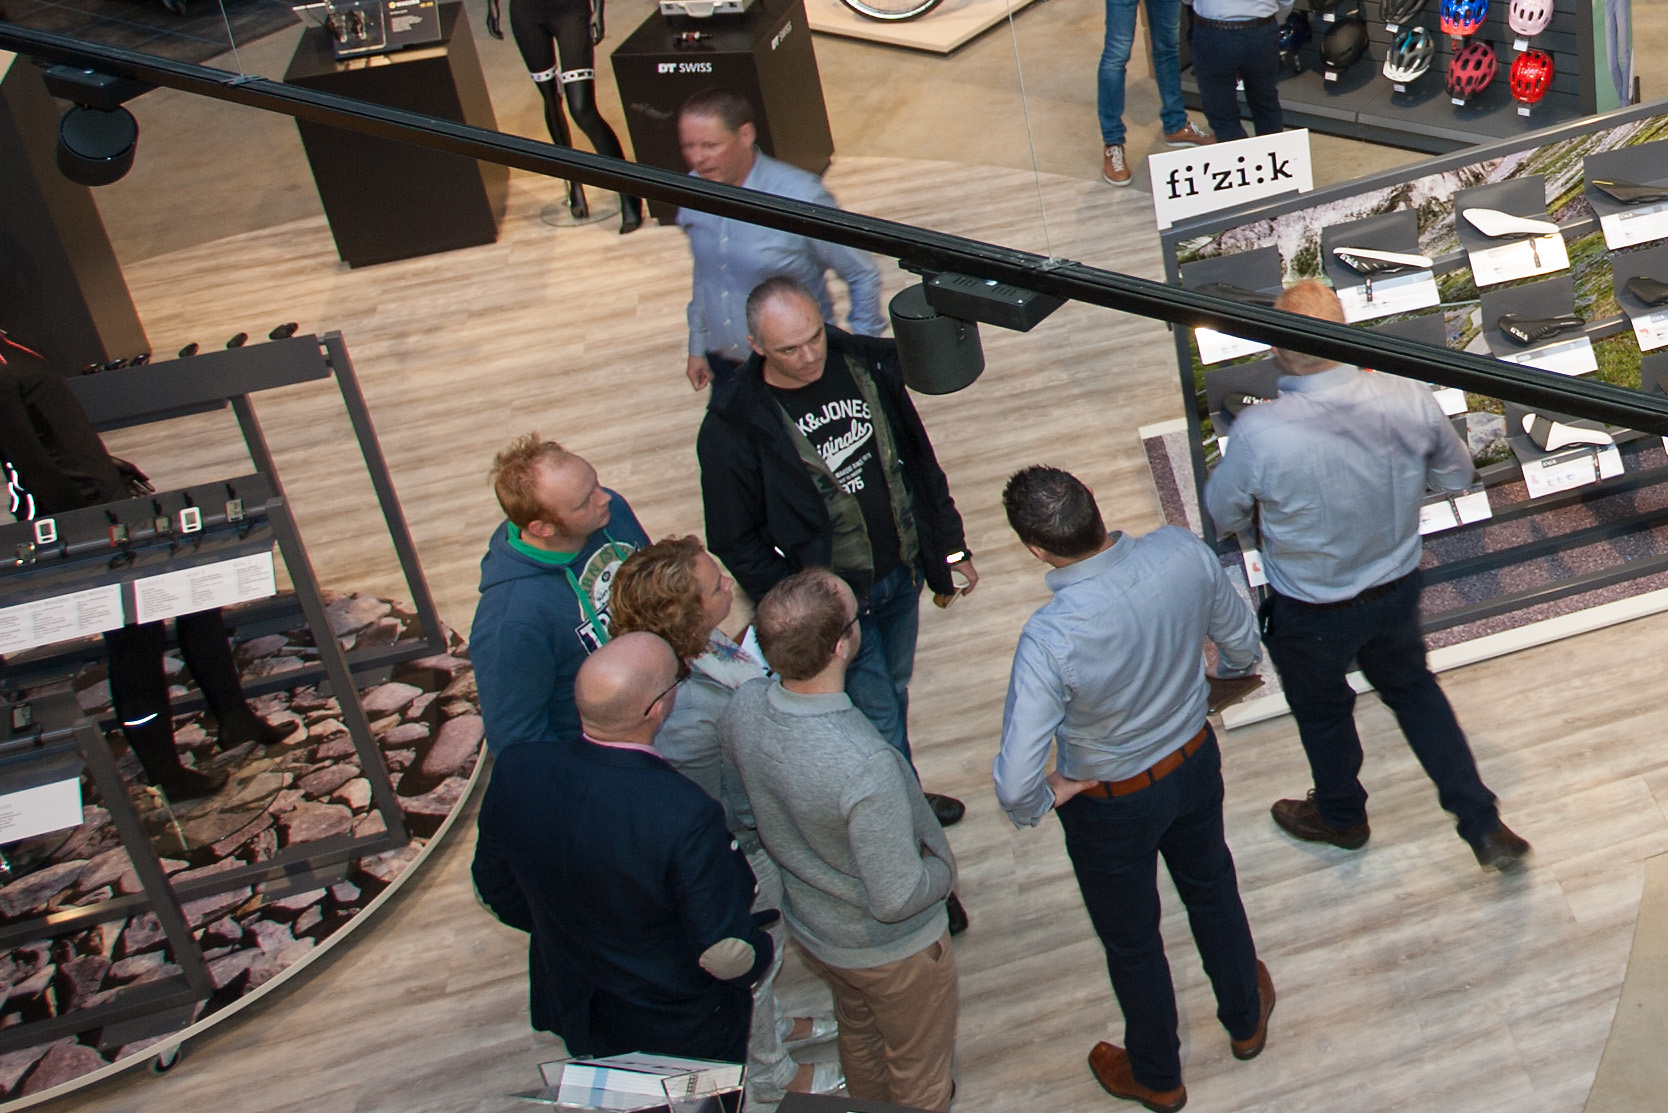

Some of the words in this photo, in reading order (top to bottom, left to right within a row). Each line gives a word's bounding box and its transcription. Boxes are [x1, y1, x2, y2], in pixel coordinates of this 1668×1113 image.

[657, 63, 677, 73] DT
[679, 62, 713, 73] SWISS
[1166, 151, 1293, 200] fi'zi:k
